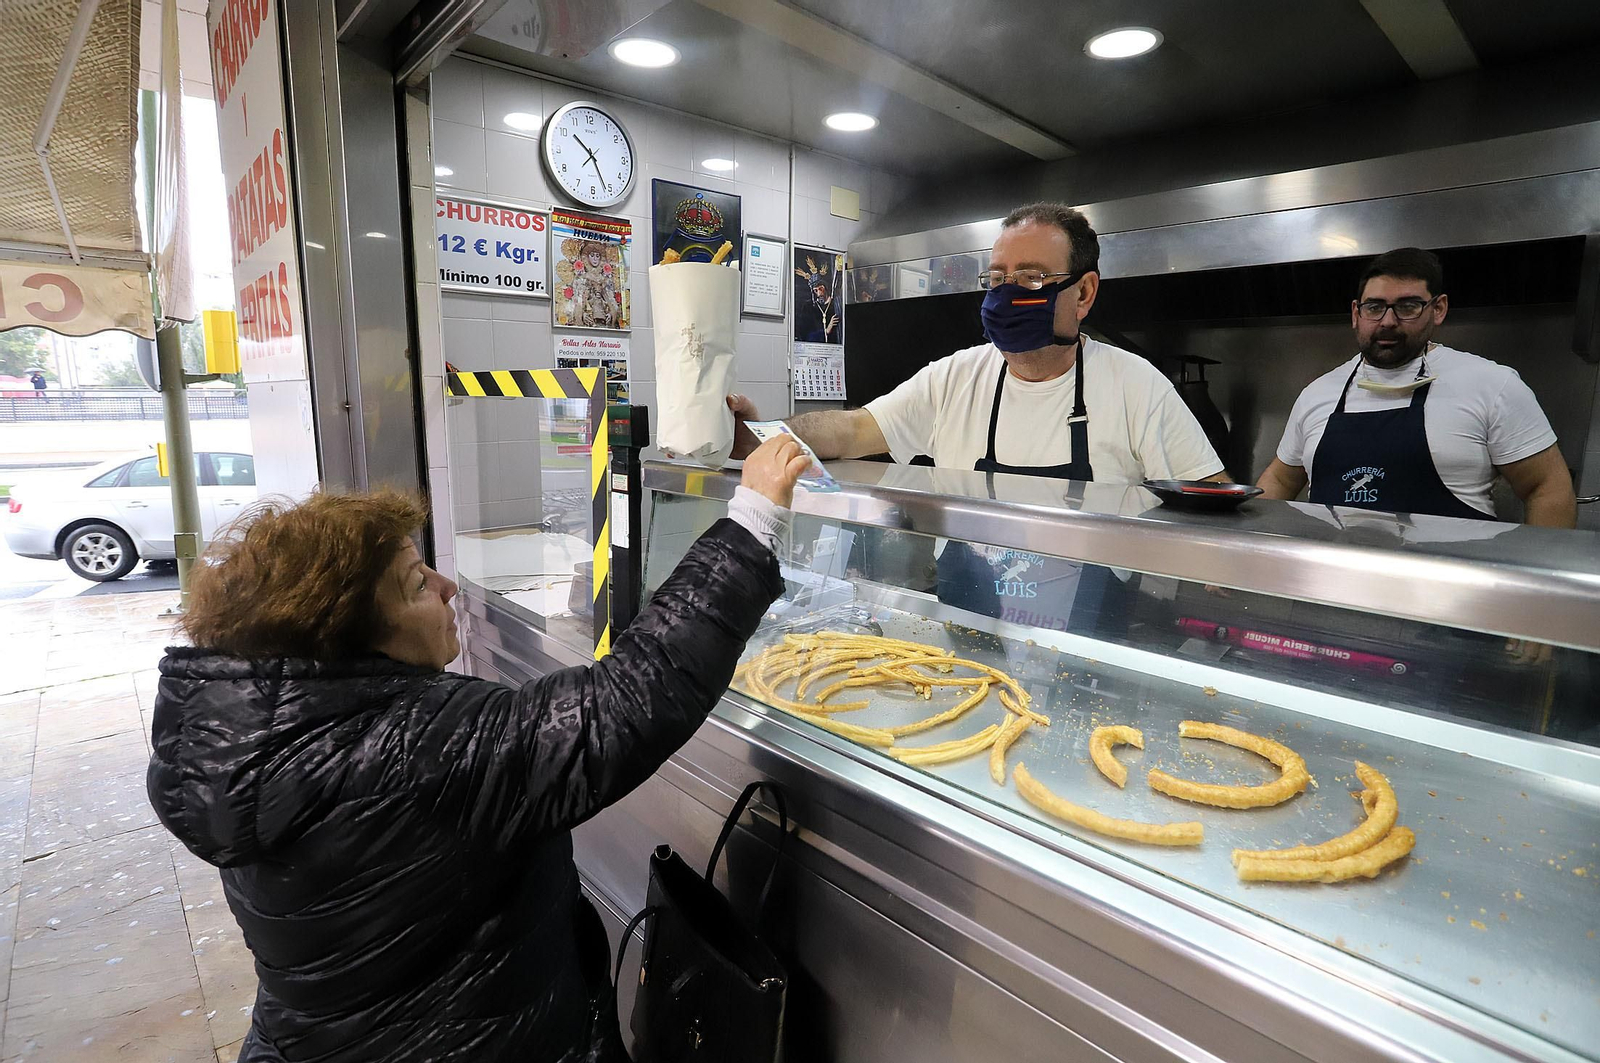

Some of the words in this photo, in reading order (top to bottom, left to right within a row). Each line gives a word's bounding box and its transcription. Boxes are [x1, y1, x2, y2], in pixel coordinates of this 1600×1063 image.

[241, 92, 248, 137] Y
[572, 117, 578, 126] 11
[586, 115, 594, 125] 12
[560, 128, 567, 137] 10
[605, 123, 608, 132] 1
[614, 135, 618, 143] 2
[621, 157, 626, 165] 3
[562, 164, 567, 172] 8
[576, 178, 580, 187] 7
[591, 186, 595, 194] 6
[608, 184, 612, 192] 5
[228, 128, 287, 267] PATATAS
[573, 229, 610, 242] HUELVA
[438, 234, 466, 253] 12
[474, 239, 487, 256] €
[496, 241, 539, 264] Kgr.
[495, 275, 521, 287] 100
[526, 280, 544, 291] gr.
[240, 261, 293, 360] FRITAS
[1342, 467, 1385, 481] CHURRERÍA
[1345, 489, 1378, 503] LUIS
[994, 581, 1038, 598] LUIS
